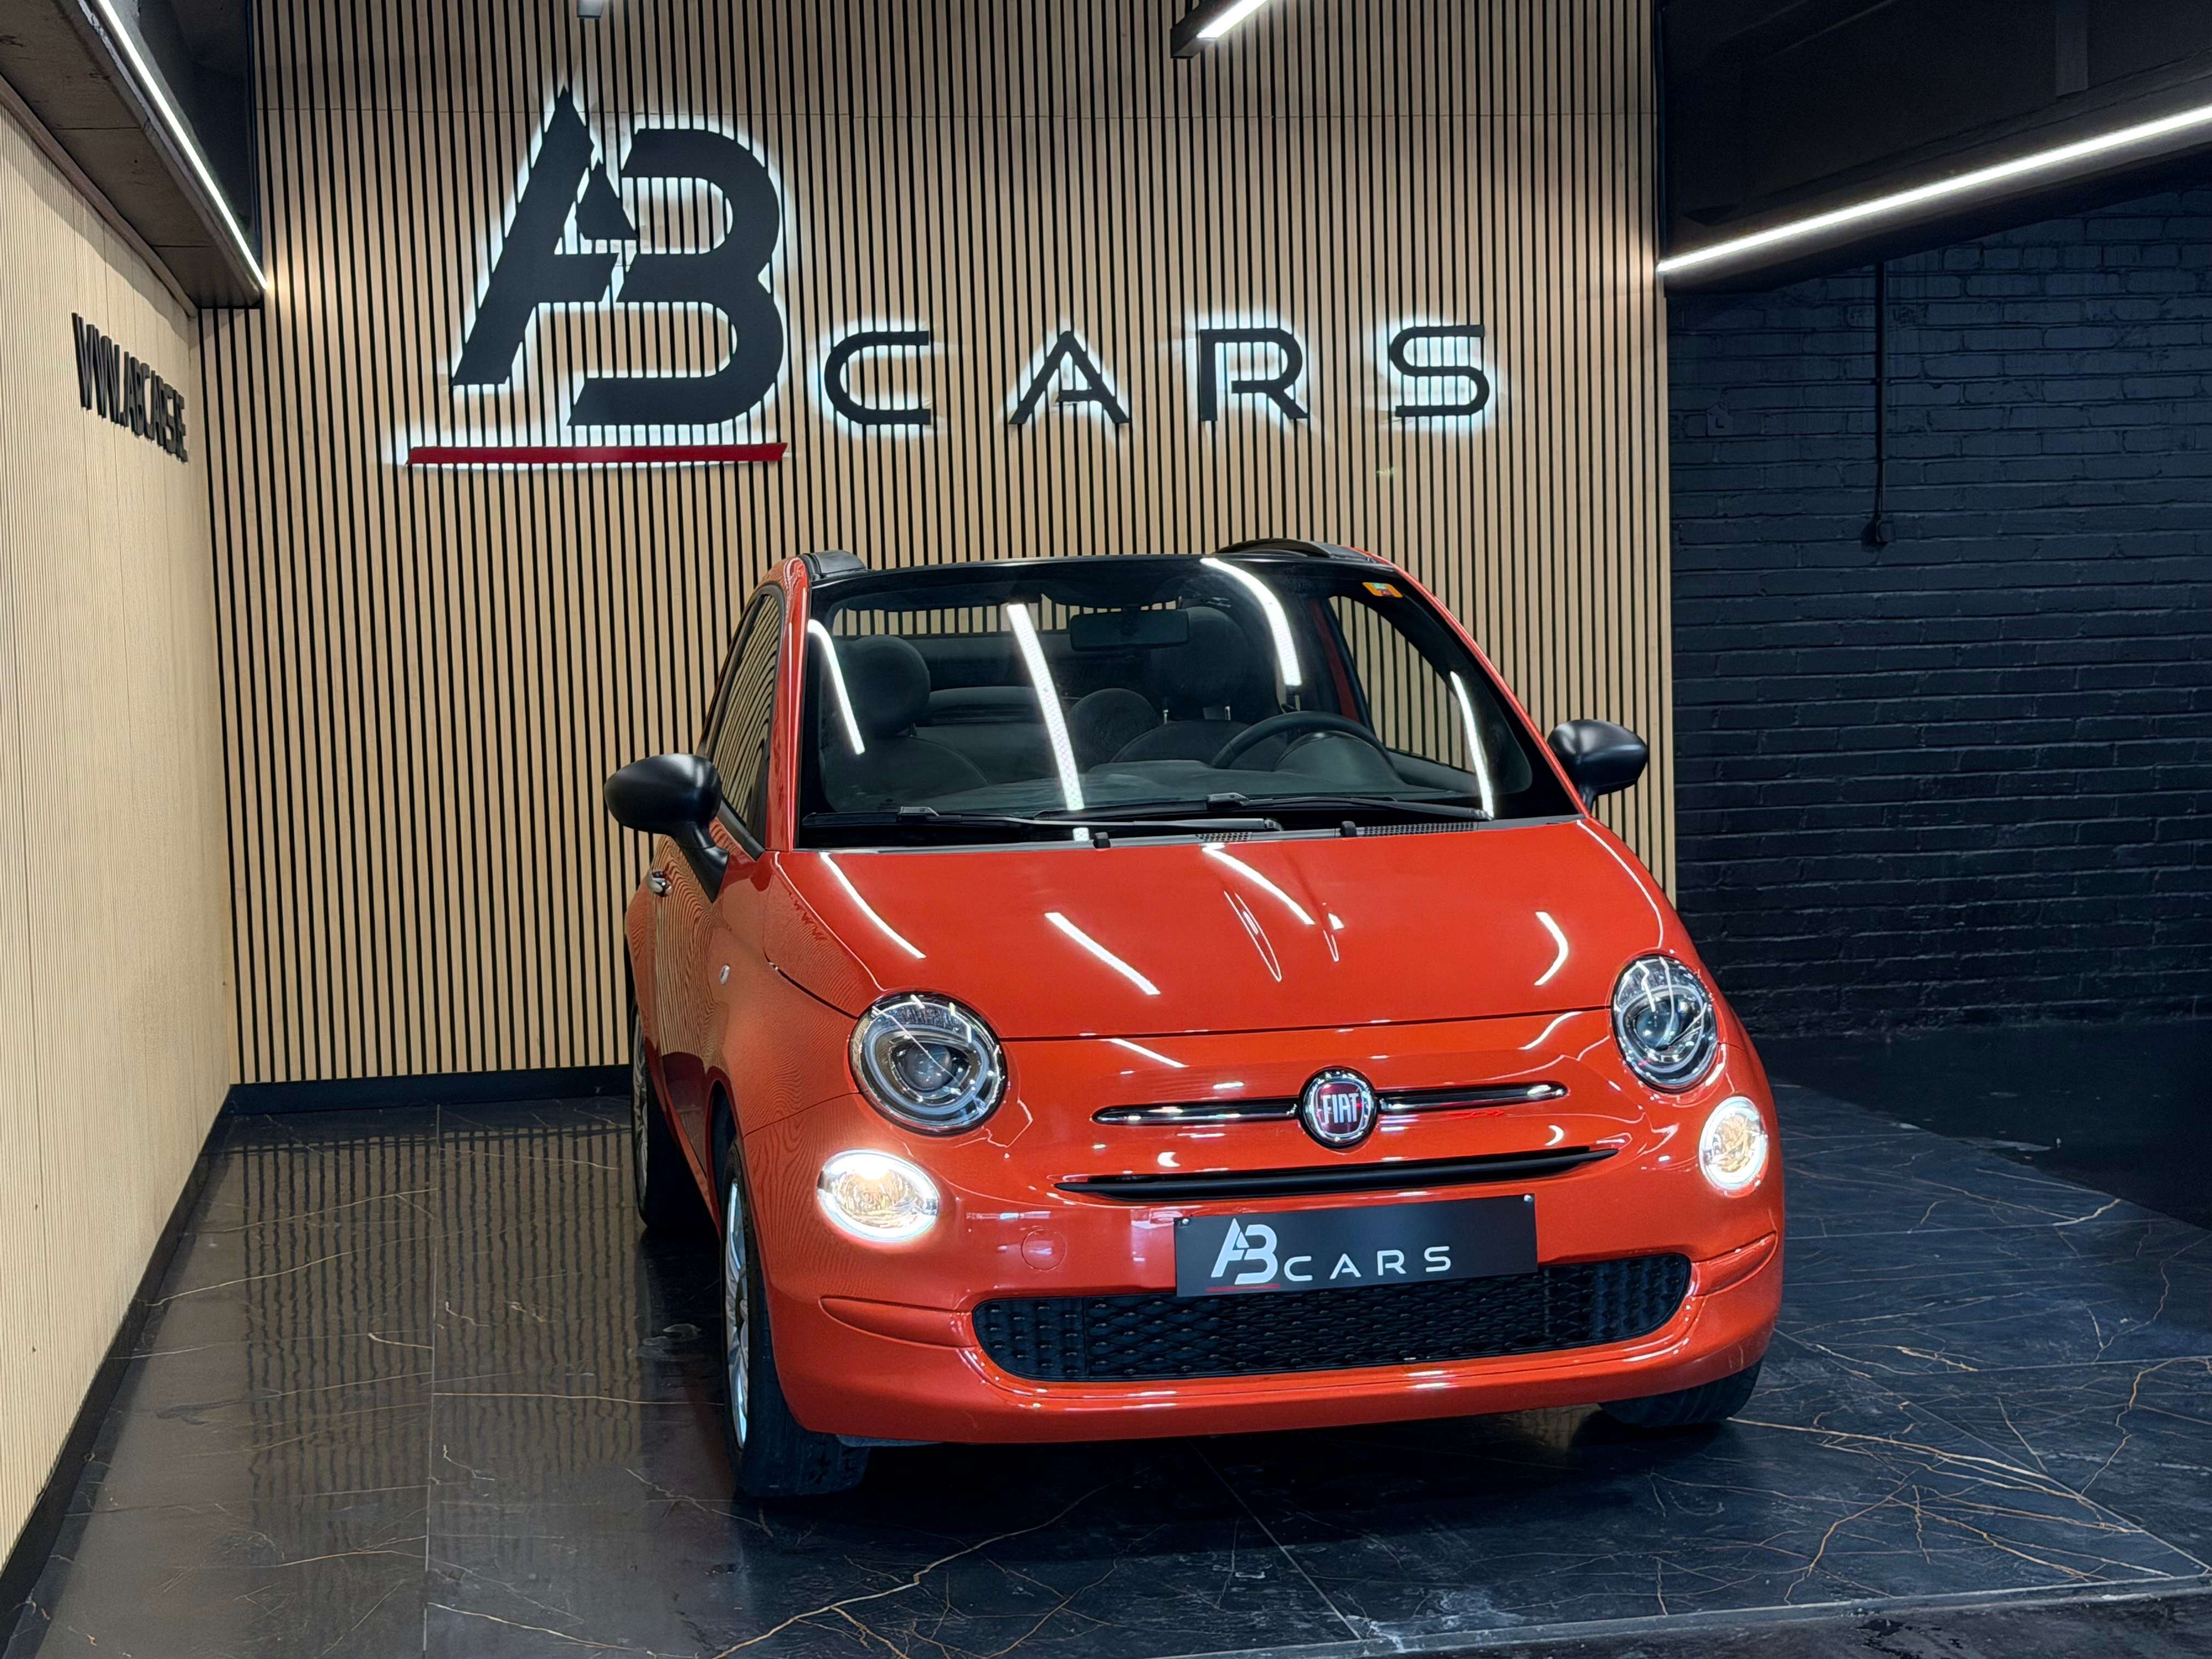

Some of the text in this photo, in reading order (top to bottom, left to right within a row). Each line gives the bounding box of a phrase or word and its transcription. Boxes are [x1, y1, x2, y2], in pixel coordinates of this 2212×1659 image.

[450, 85, 1490, 426] AB CARS
[1322, 1093, 1359, 1124] FIAT
[1211, 1218, 1451, 1285] AB CARS
